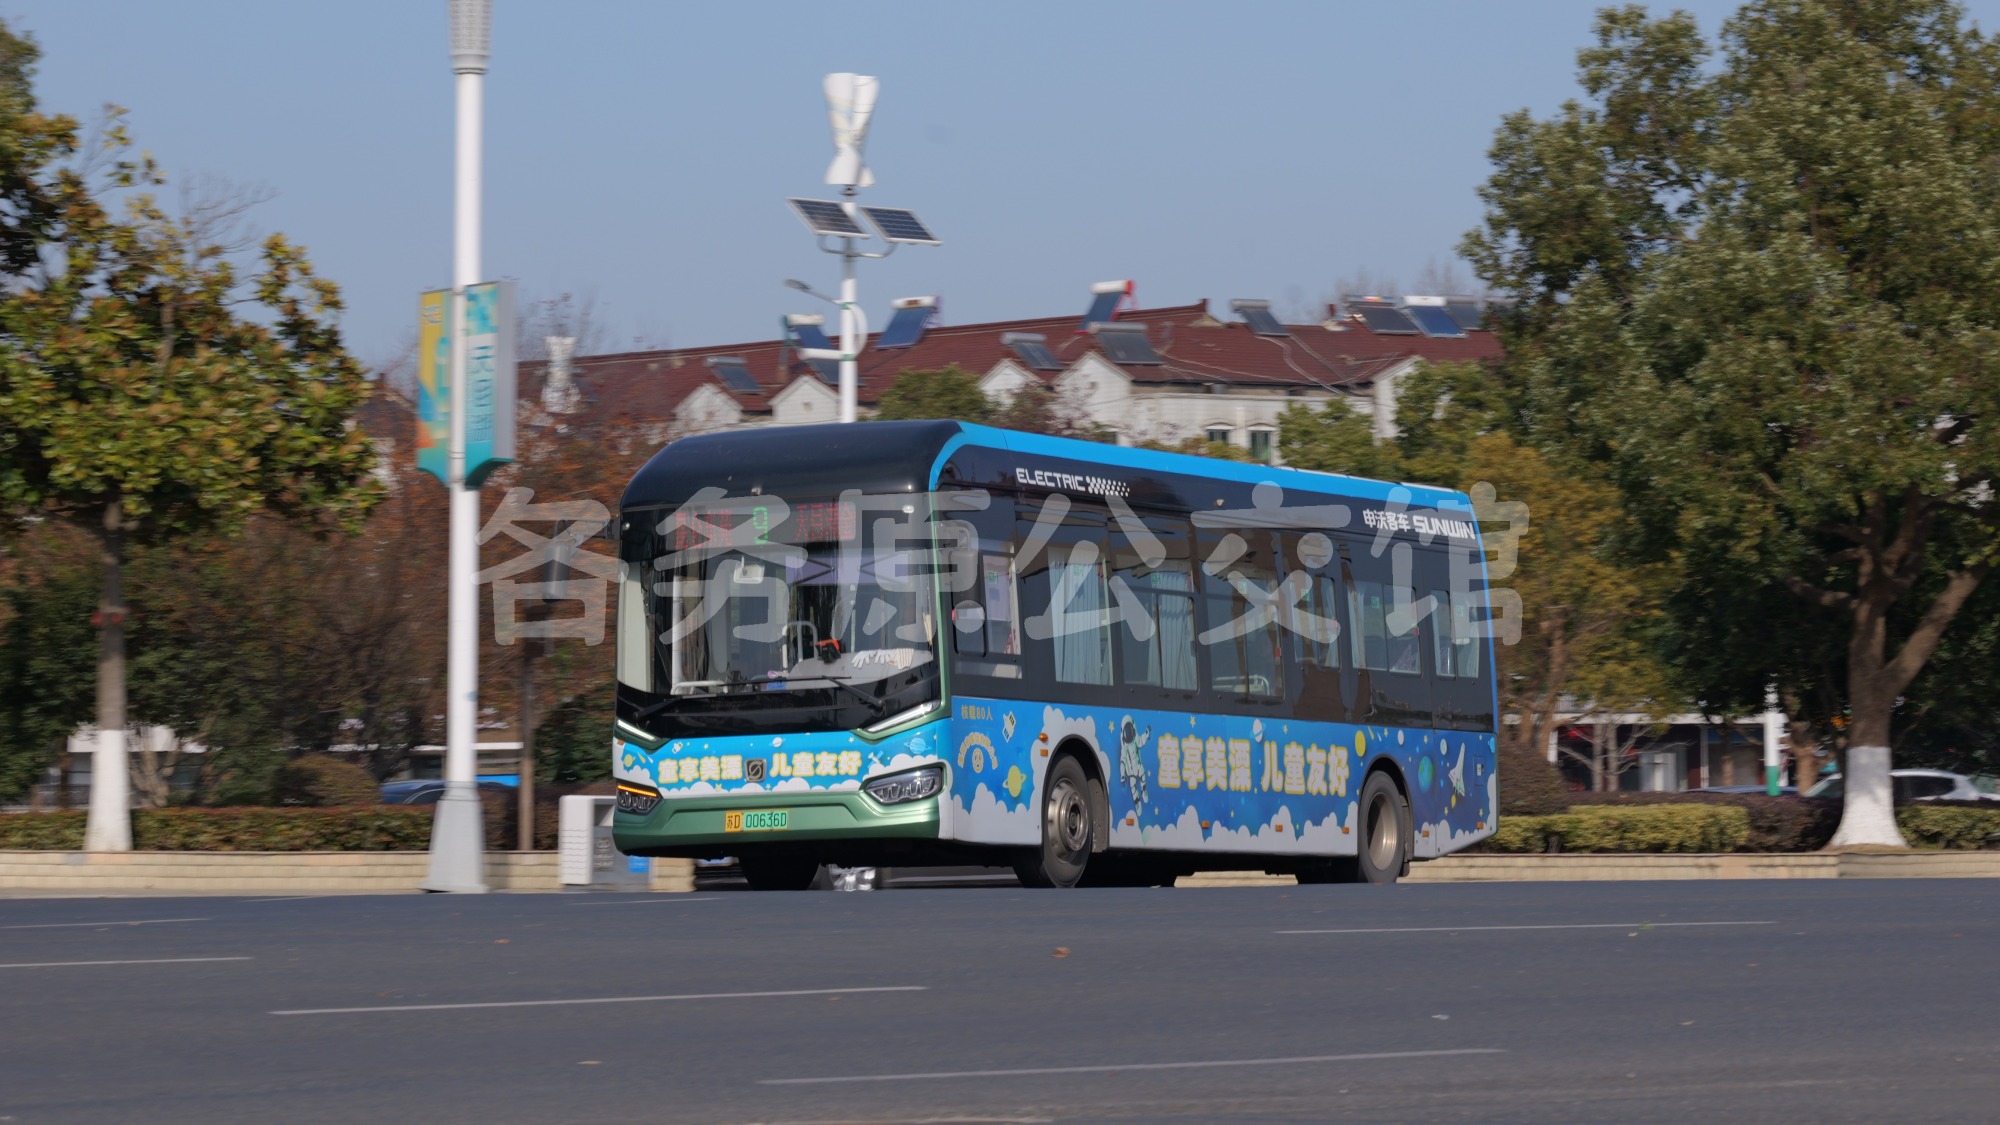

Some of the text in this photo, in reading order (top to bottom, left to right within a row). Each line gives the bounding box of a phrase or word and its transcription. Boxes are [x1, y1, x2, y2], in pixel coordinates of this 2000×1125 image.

[1016, 467, 1085, 491] ELECTRIC
[752, 506, 768, 545] 9
[1363, 508, 1476, 540] 申沃客车 SUNWIN
[769, 751, 862, 778] 儿童友好
[1261, 740, 1349, 798] 儿童友好
